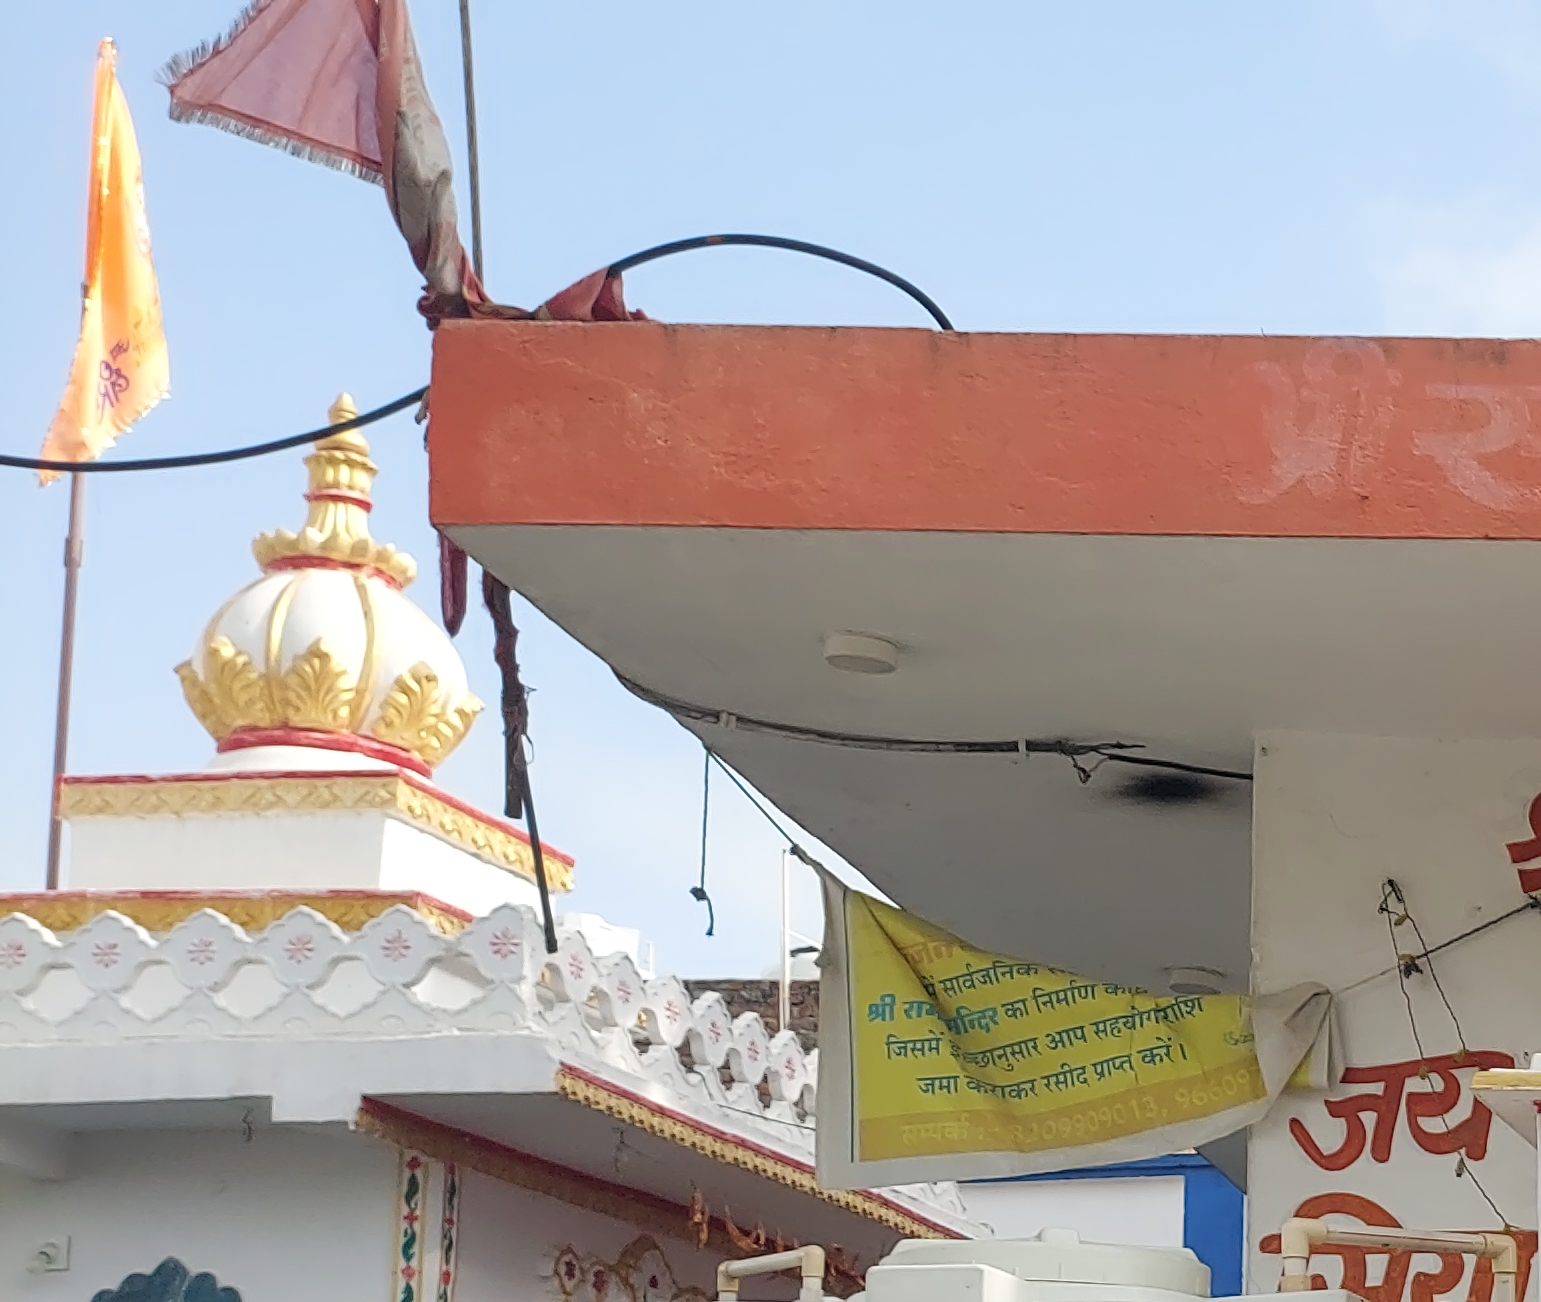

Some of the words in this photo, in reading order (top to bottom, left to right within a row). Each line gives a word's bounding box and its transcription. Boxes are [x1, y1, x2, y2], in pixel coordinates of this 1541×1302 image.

[1001, 1000, 1029, 1020] का
[1045, 1026, 1089, 1052] आप
[917, 1074, 960, 1097] जमा
[1288, 1050, 1515, 1172] जय
